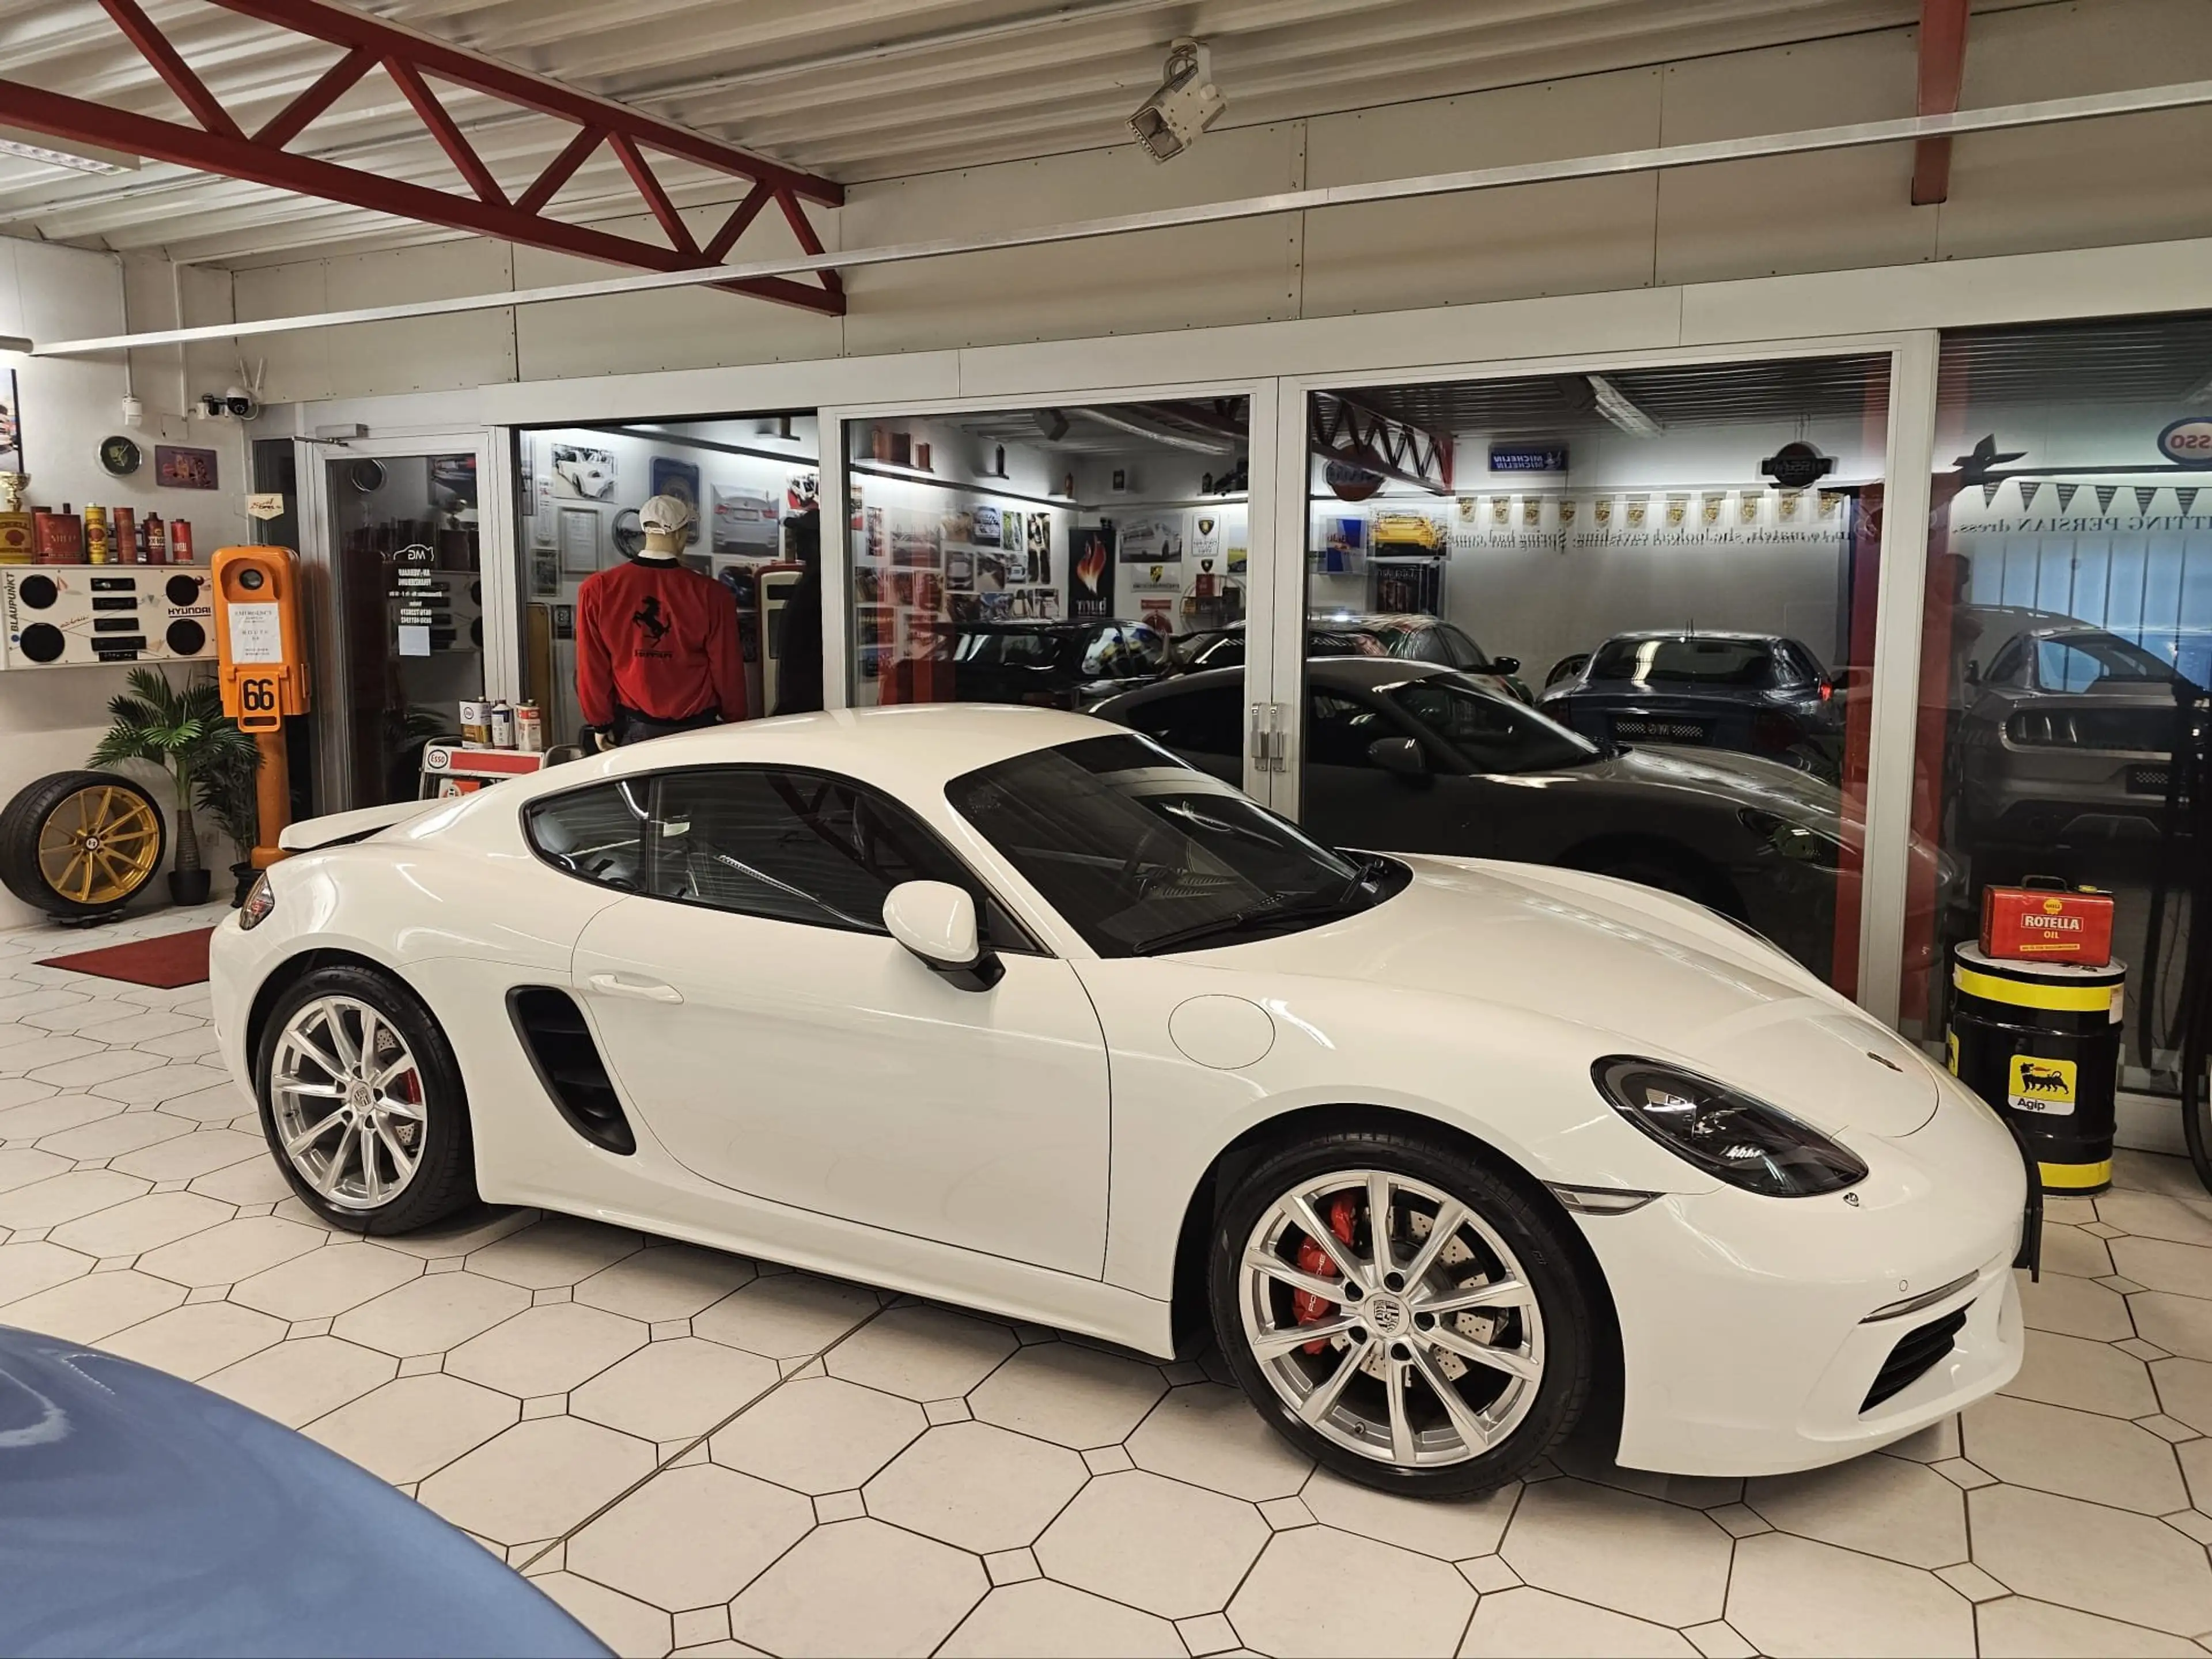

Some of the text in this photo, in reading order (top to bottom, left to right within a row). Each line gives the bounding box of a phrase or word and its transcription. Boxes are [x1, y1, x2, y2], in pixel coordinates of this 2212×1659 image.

[6, 572, 18, 632] BLAUPUNKT
[168, 607, 211, 616] HYUNDAI
[243, 679, 275, 710] 66
[2024, 915, 2080, 930] ROTELLA
[2043, 931, 2061, 939] OIL
[2017, 1097, 2046, 1111] Agip
